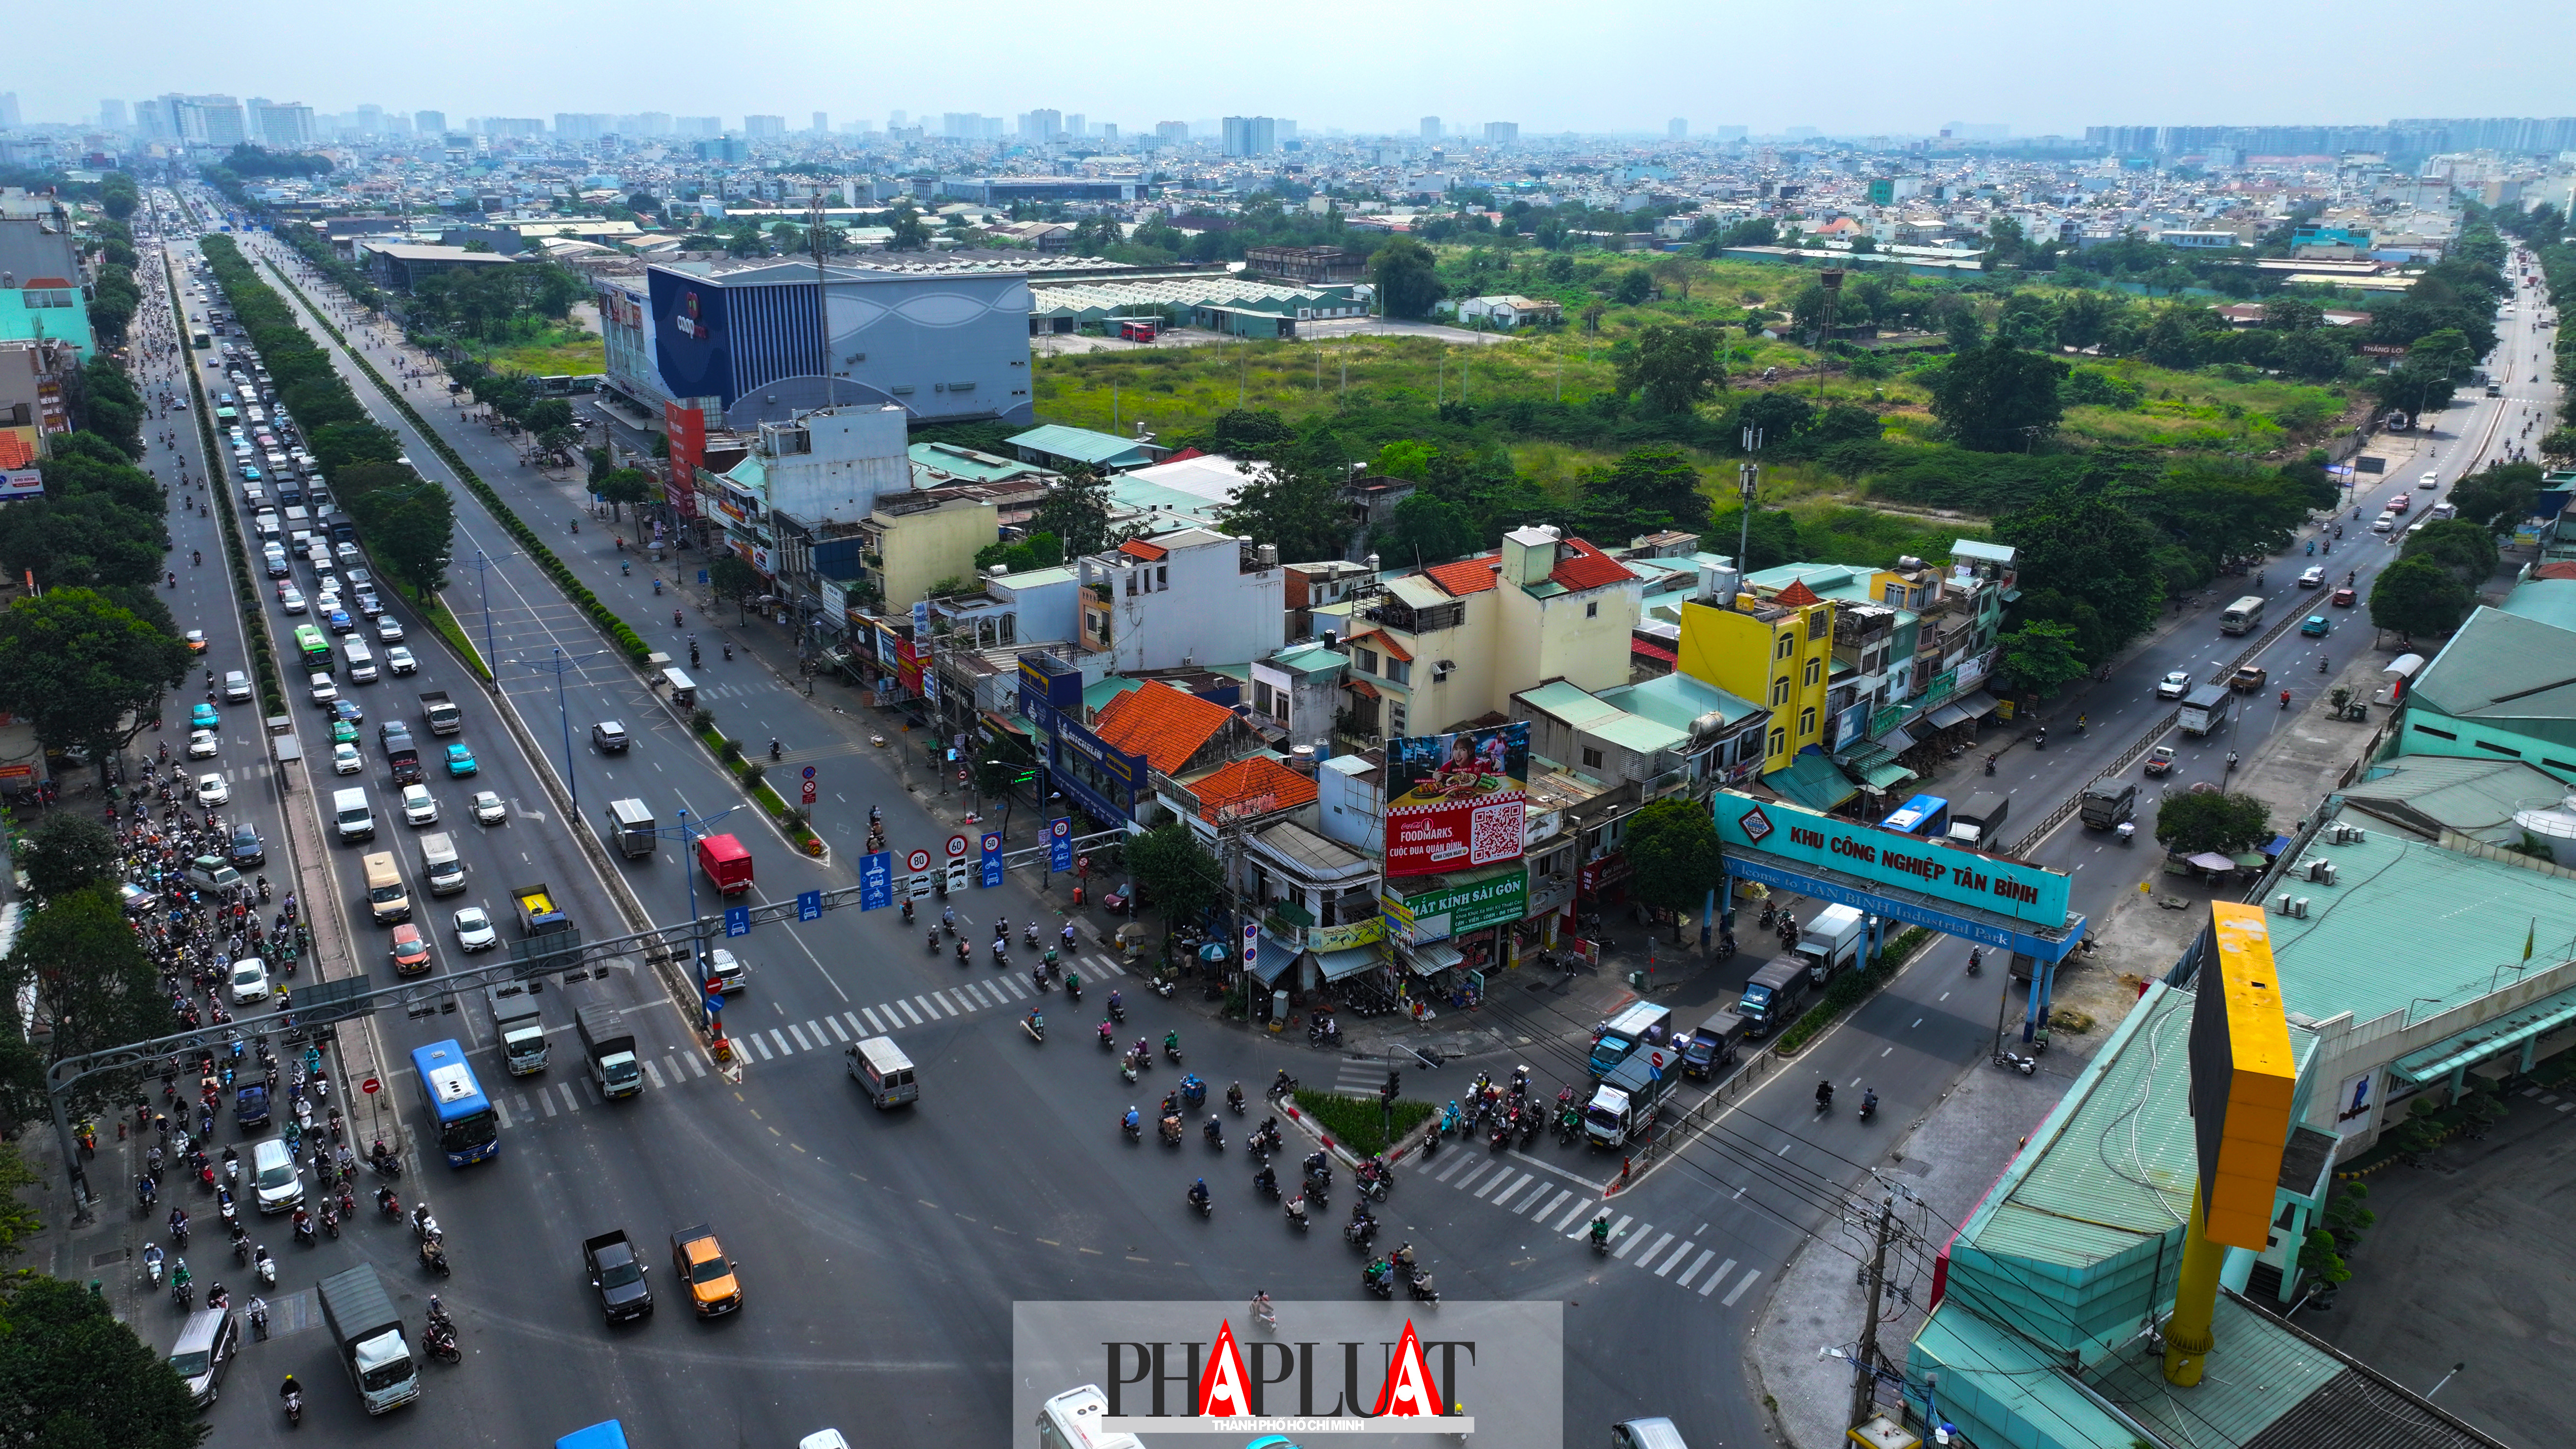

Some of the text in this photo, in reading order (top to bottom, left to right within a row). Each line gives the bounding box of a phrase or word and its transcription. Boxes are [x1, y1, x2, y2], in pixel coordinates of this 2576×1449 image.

[944, 685, 956, 701] CAO
[1068, 731, 1103, 761] MICHELIN
[1057, 825, 1065, 833] 50
[1401, 822, 1421, 830] Coca-Cola
[952, 841, 962, 851] 60
[987, 840, 995, 848] 50
[1389, 839, 1462, 859] CUỘC ĐUA QUÁN ĐỈNH
[914, 855, 924, 866] 80
[1790, 826, 2038, 905] KHU CÔNG NGHIỆP TÂN BÌNH
[1409, 880, 1521, 917] MẮT KÍNH SÀI GÒN
[1722, 860, 2008, 946] Wlcome to TAN BINH Industrial Park
[1468, 909, 1479, 918] Khúc
[1469, 915, 1479, 923] VIỄN
[1507, 905, 1523, 914] TRÒNG
